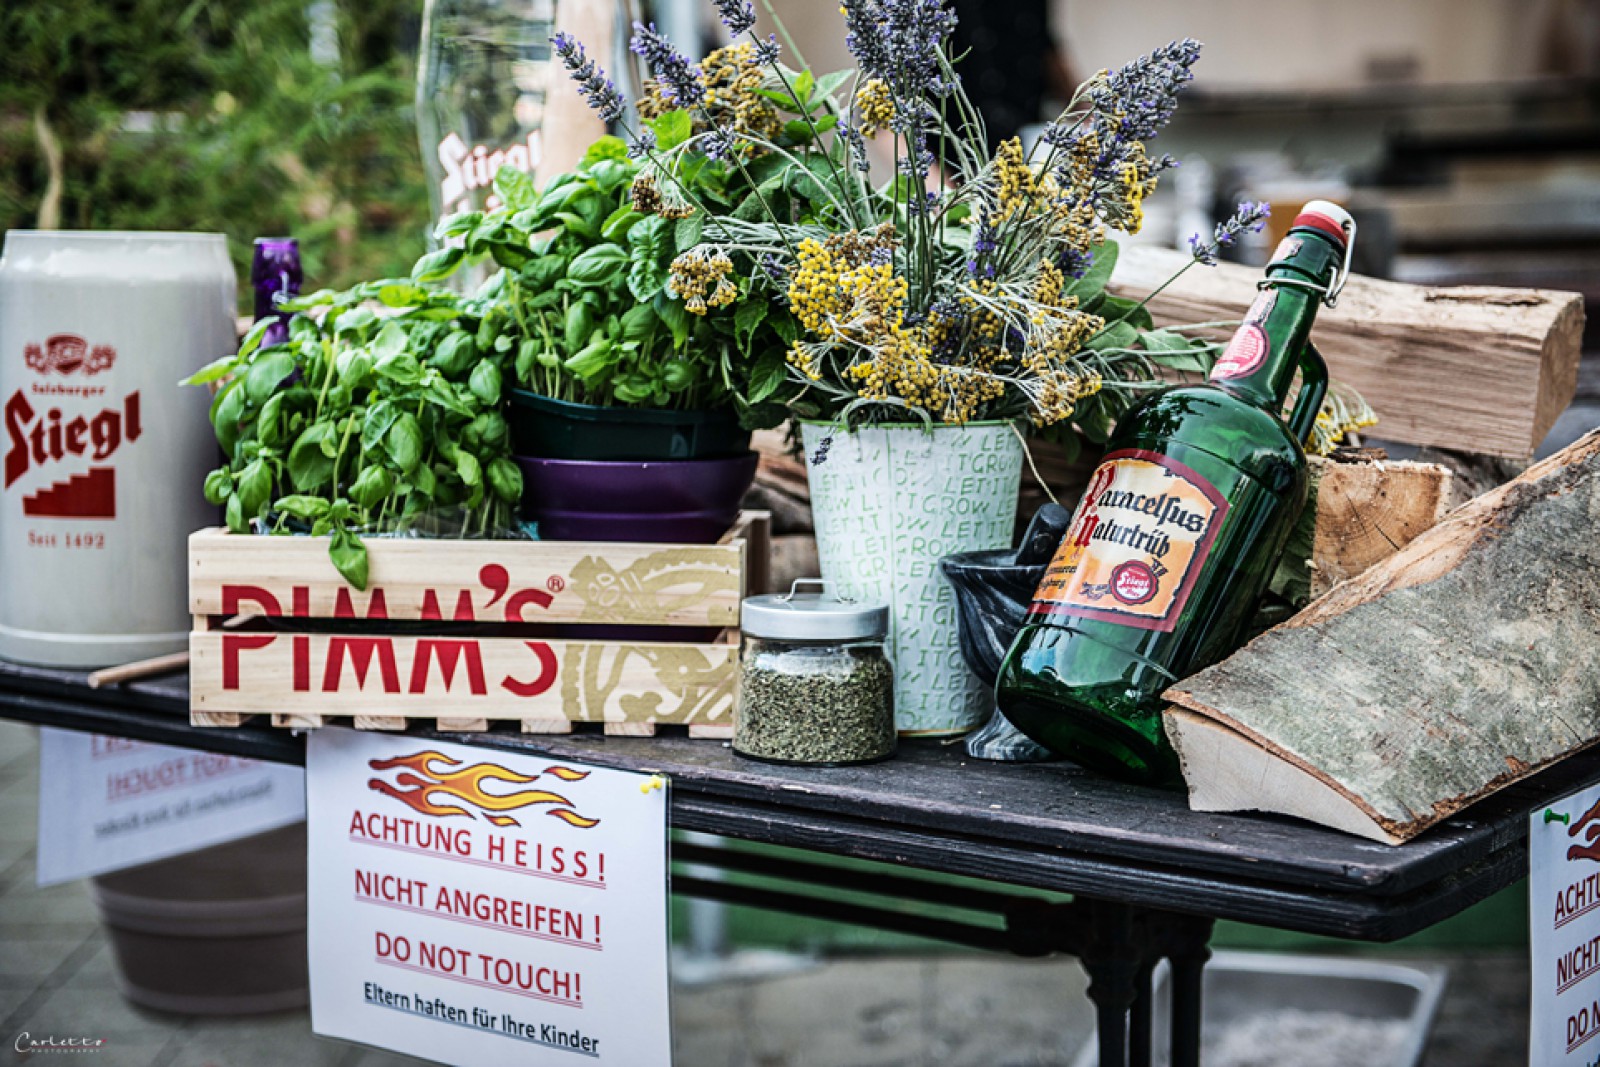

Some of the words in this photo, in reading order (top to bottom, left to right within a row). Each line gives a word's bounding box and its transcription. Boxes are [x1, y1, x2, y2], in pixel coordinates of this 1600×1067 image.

[4, 388, 142, 489] Stiegl
[27, 532, 56, 548] Seit
[65, 532, 105, 549] 1492
[221, 563, 559, 697] PIMM'S
[350, 810, 472, 856] ACHTUNG
[488, 834, 605, 882] HEISS!
[354, 869, 428, 908] NICHT
[435, 886, 583, 941] ANGREIFEN
[1554, 872, 1600, 922] ACHT
[375, 931, 411, 962] DO
[419, 941, 471, 976] NOT
[478, 954, 582, 1001] TOUCH!
[364, 982, 411, 1010] Eltern
[414, 994, 469, 1024] haften
[472, 1007, 497, 1030] für
[502, 1014, 536, 1038] Ihre
[540, 1023, 599, 1054] Kinder
[1567, 1007, 1589, 1046] DO
